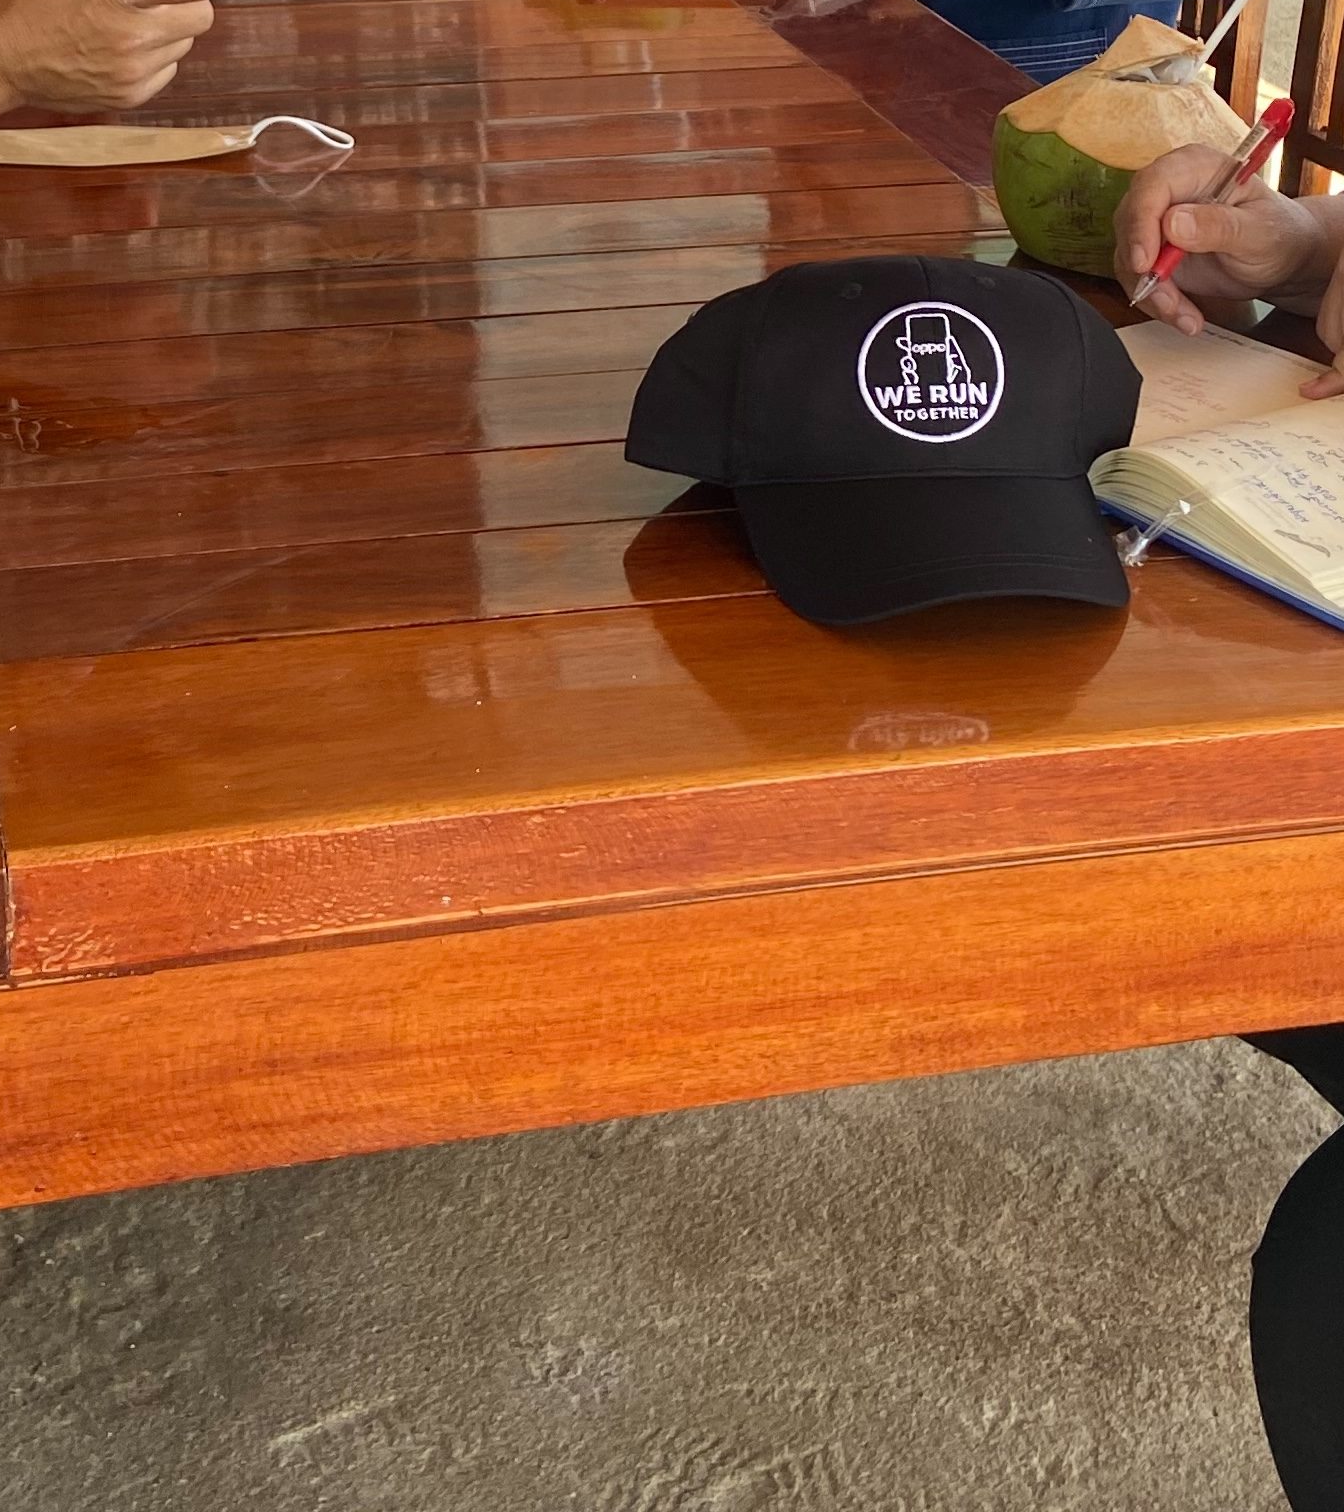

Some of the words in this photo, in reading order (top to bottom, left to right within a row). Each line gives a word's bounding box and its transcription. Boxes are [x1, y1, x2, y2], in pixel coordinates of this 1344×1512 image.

[875, 384, 922, 409] WE
[929, 381, 989, 407] RUN
[894, 406, 980, 422] TOGETHER
